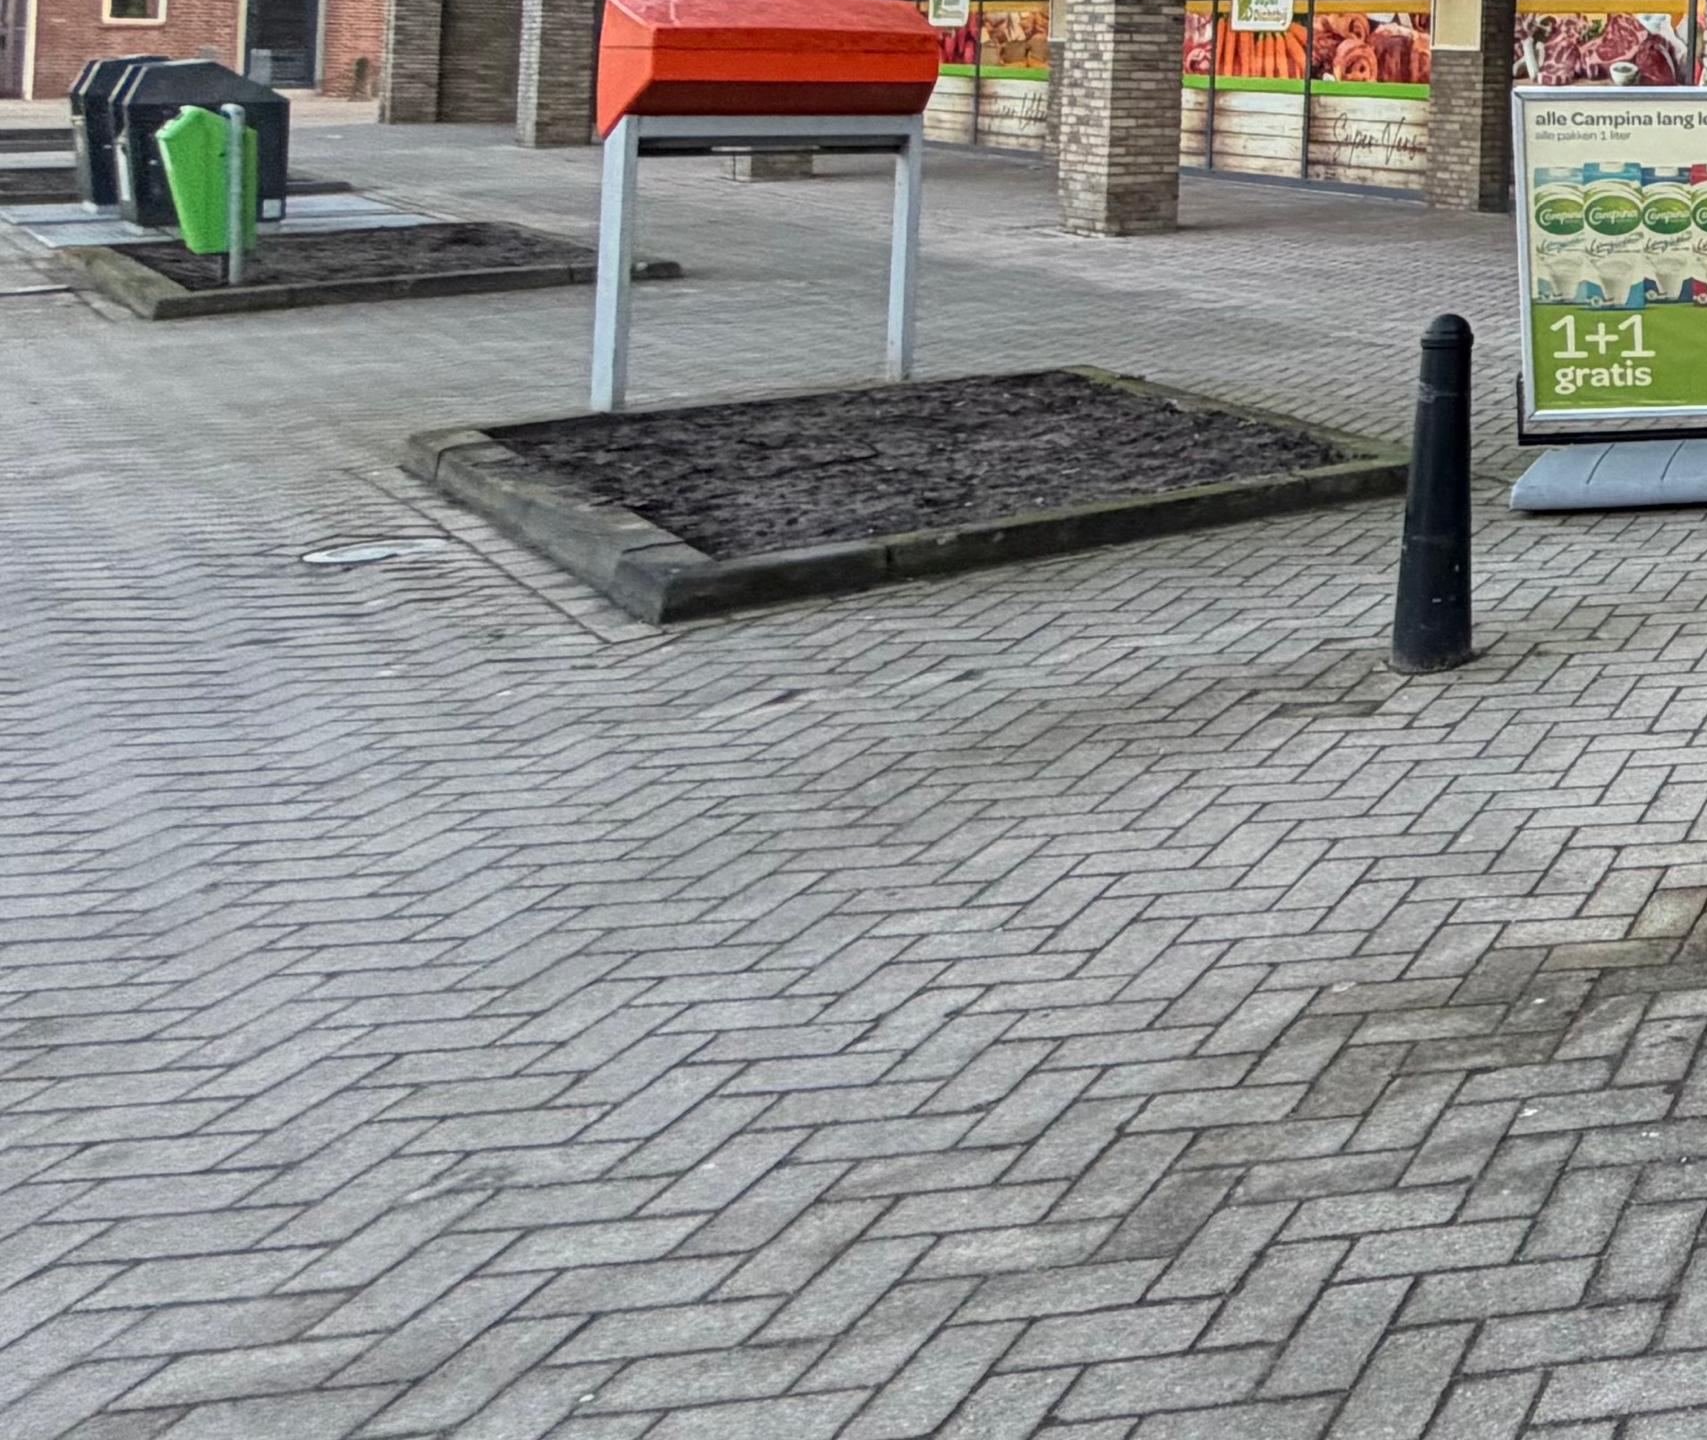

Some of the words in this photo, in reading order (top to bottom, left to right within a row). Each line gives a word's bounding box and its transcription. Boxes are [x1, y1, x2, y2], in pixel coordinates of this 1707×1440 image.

[1535, 111, 1567, 126] alle
[1571, 111, 1654, 129] Campina
[1657, 111, 1695, 130] lang
[1550, 313, 1657, 359] 1+1
[1554, 359, 1653, 396] gratis
